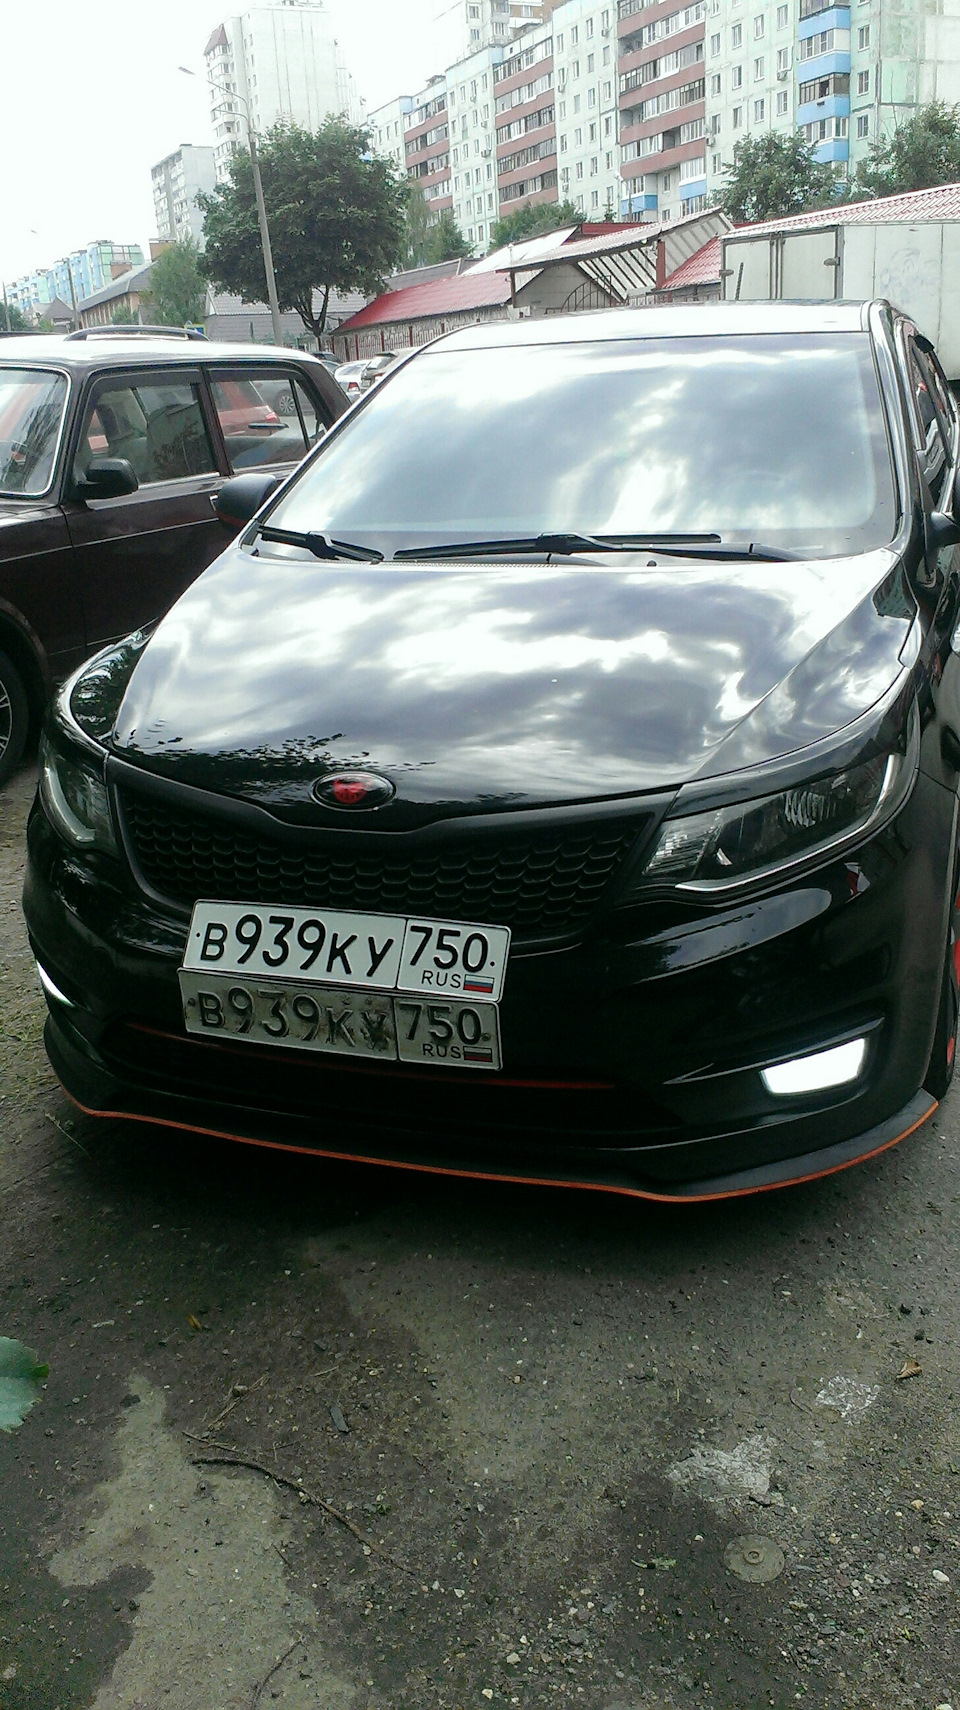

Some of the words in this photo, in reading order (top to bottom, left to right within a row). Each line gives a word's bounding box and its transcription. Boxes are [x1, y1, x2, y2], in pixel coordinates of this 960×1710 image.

[410, 925, 489, 973] 750
[421, 970, 462, 989] RUS
[400, 1002, 482, 1045] 750
[422, 1043, 462, 1059] RUS
